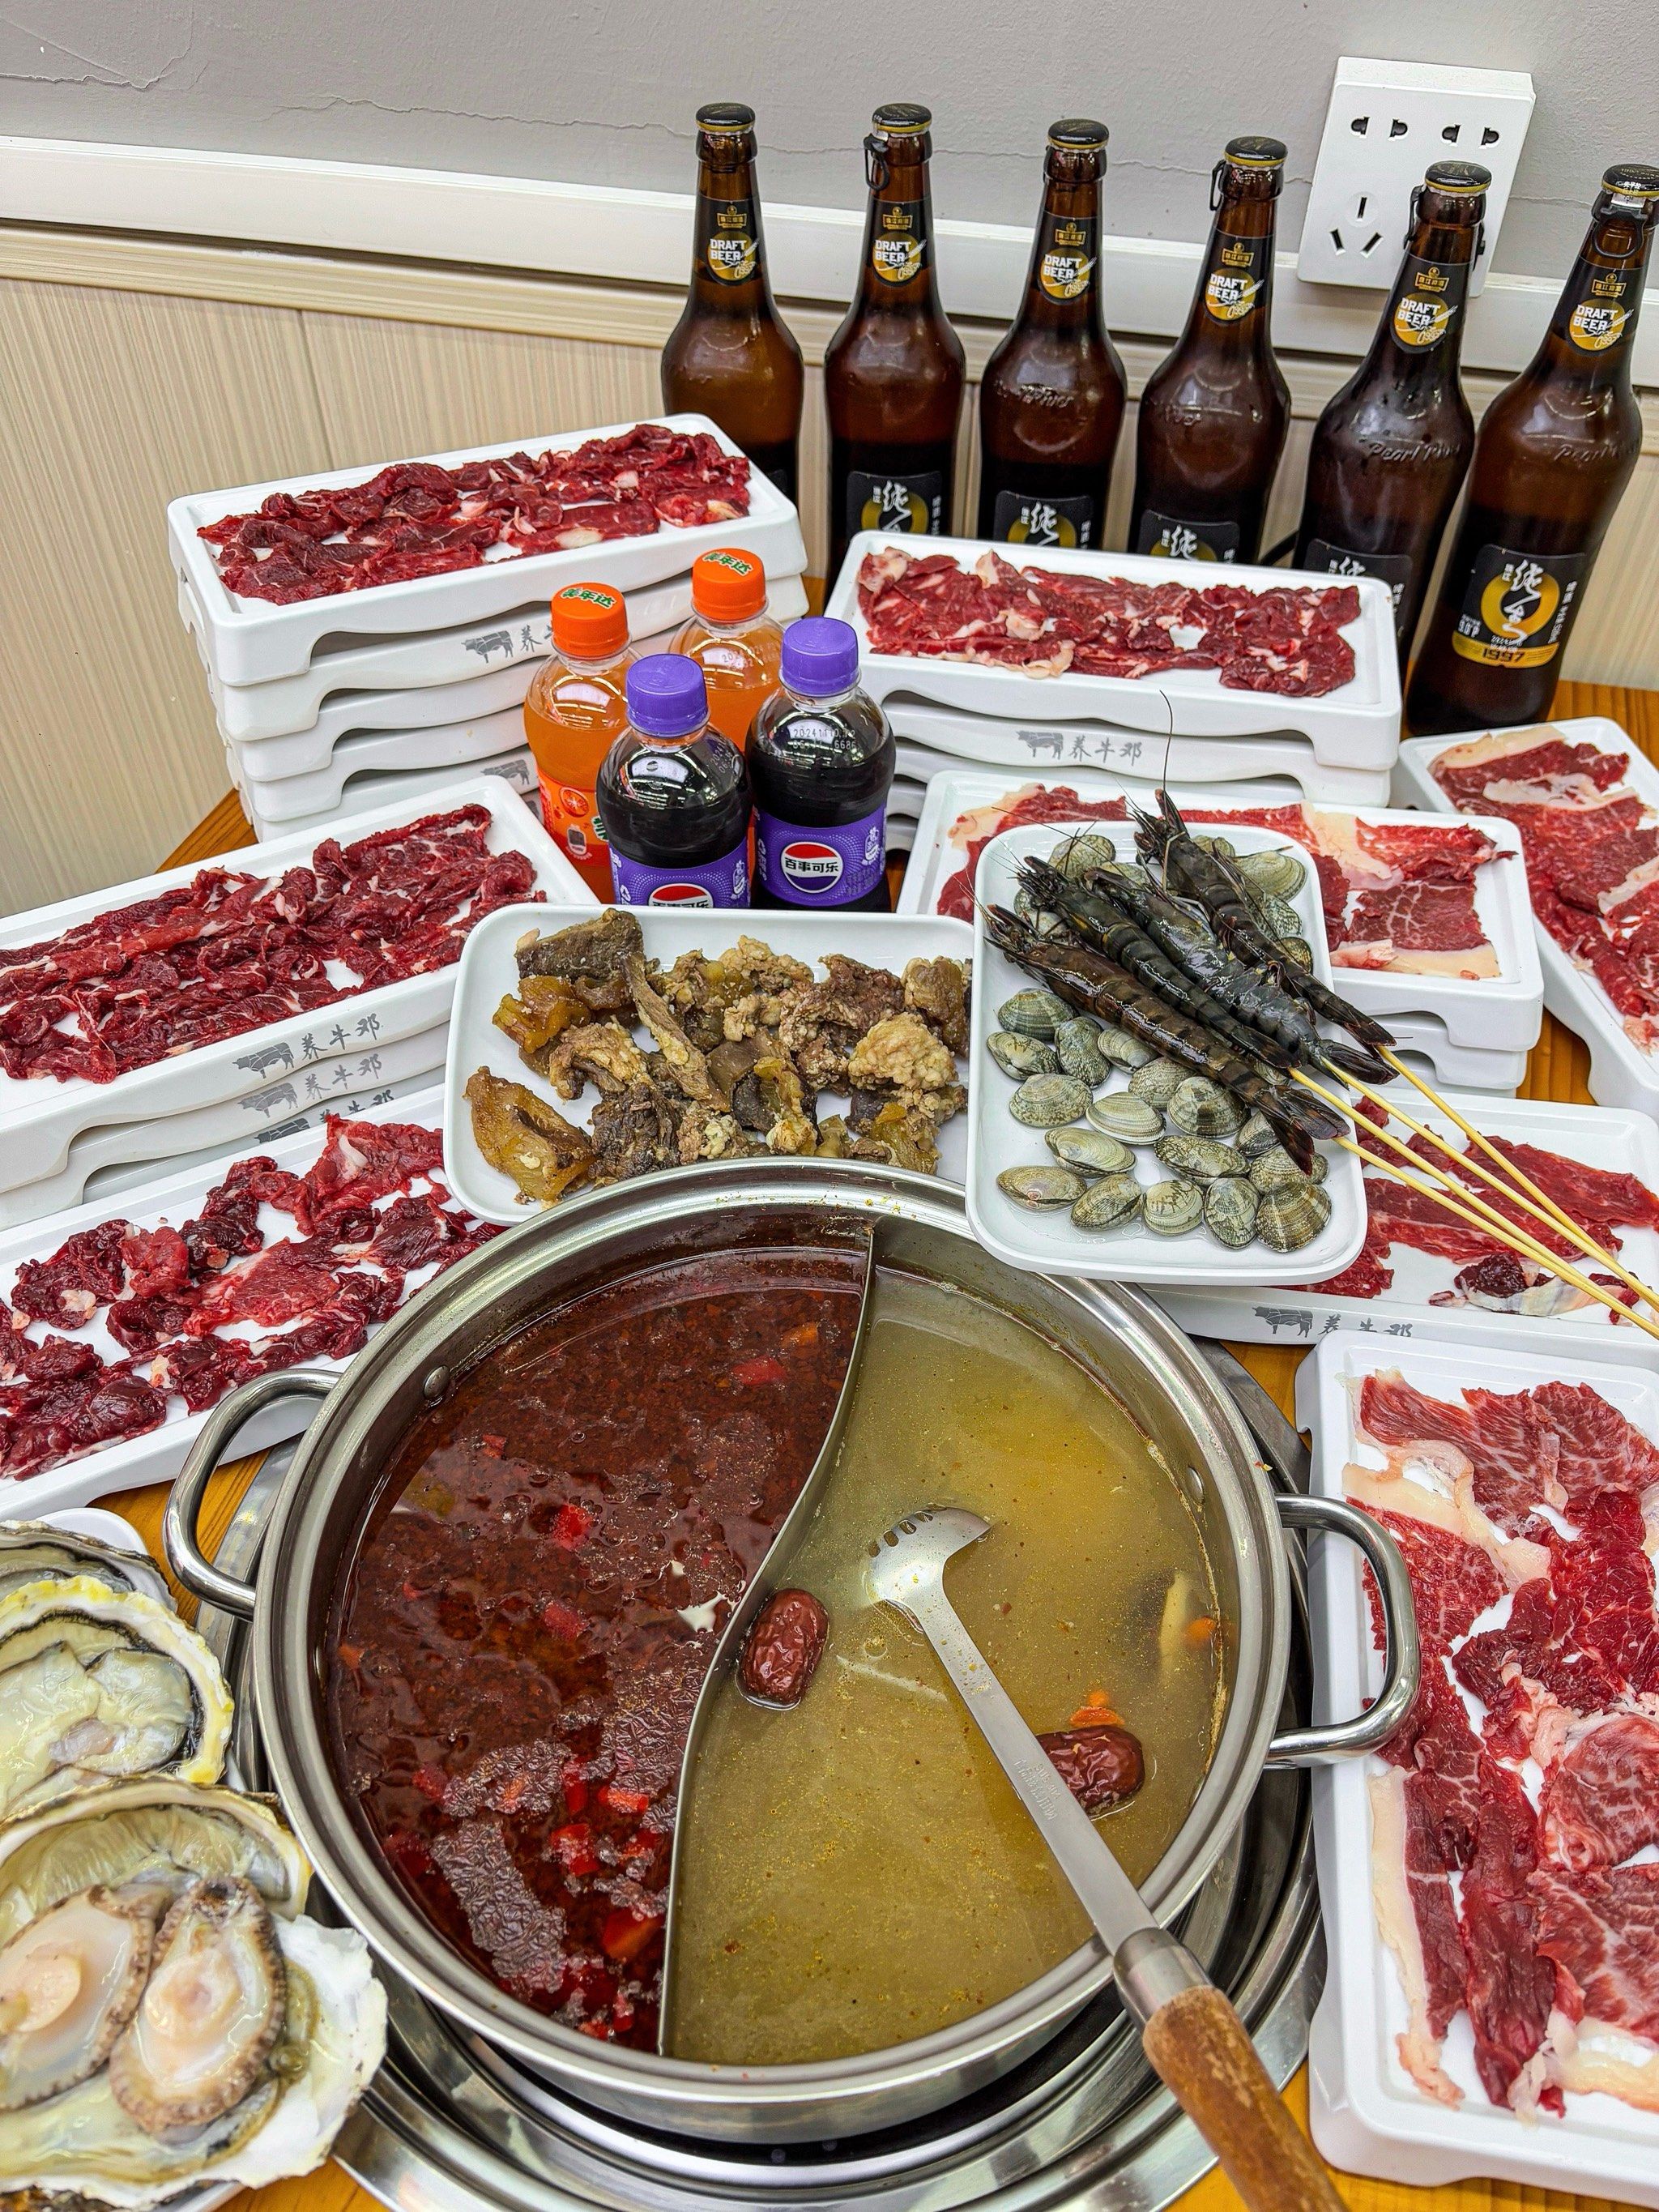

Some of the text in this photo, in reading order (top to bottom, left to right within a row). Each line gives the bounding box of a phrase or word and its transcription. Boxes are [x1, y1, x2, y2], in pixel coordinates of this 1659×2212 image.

[710, 238, 747, 250] DRAFT
[875, 239, 912, 252] DRAFT
[710, 250, 741, 261] BEER
[876, 250, 906, 263] BEER
[1044, 254, 1083, 269] DRAFT
[1043, 264, 1075, 279] BEER
[1209, 273, 1248, 290] DRAFT
[1207, 284, 1239, 300] BEER
[1400, 297, 1442, 315] DRAFT
[1576, 304, 1618, 320] DRAFT
[1397, 310, 1431, 326] BEER
[1573, 315, 1609, 331] BEER
[561, 587, 617, 609] 美年达
[784, 857, 839, 873] 百事可乐
